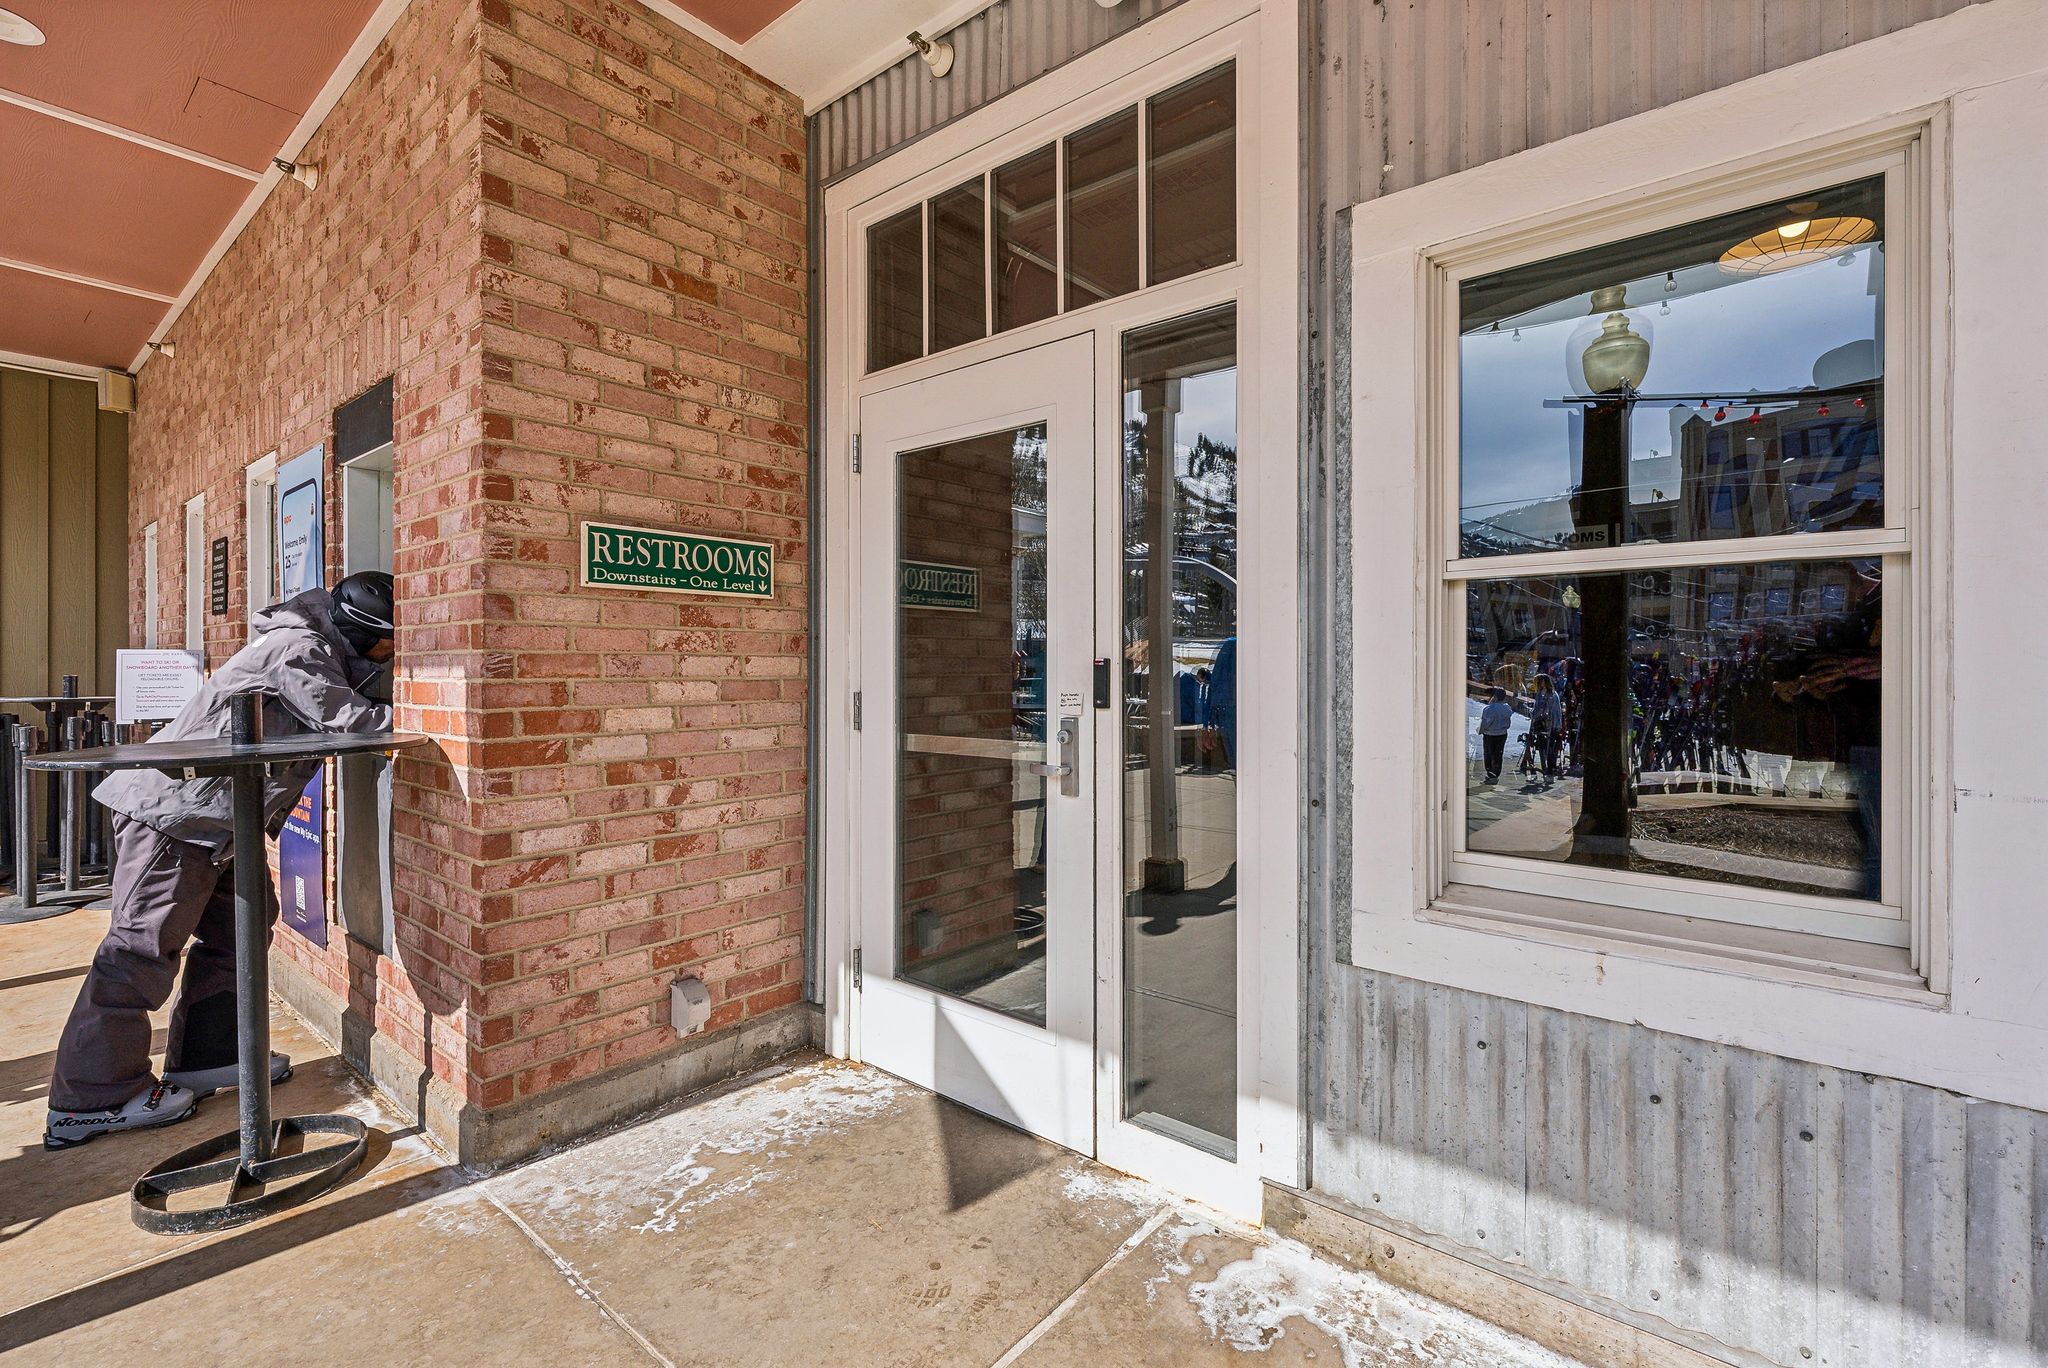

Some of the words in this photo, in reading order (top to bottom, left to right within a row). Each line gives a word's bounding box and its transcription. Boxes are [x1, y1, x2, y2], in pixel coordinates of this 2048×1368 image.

[590, 531, 769, 578] RESTROOMS
[285, 555, 291, 569] 25
[592, 567, 677, 585] Downstairs
[690, 575, 718, 588] One
[723, 578, 754, 592] Level
[290, 808, 310, 822] OUNTAIN
[53, 1116, 128, 1128] NORDICA
